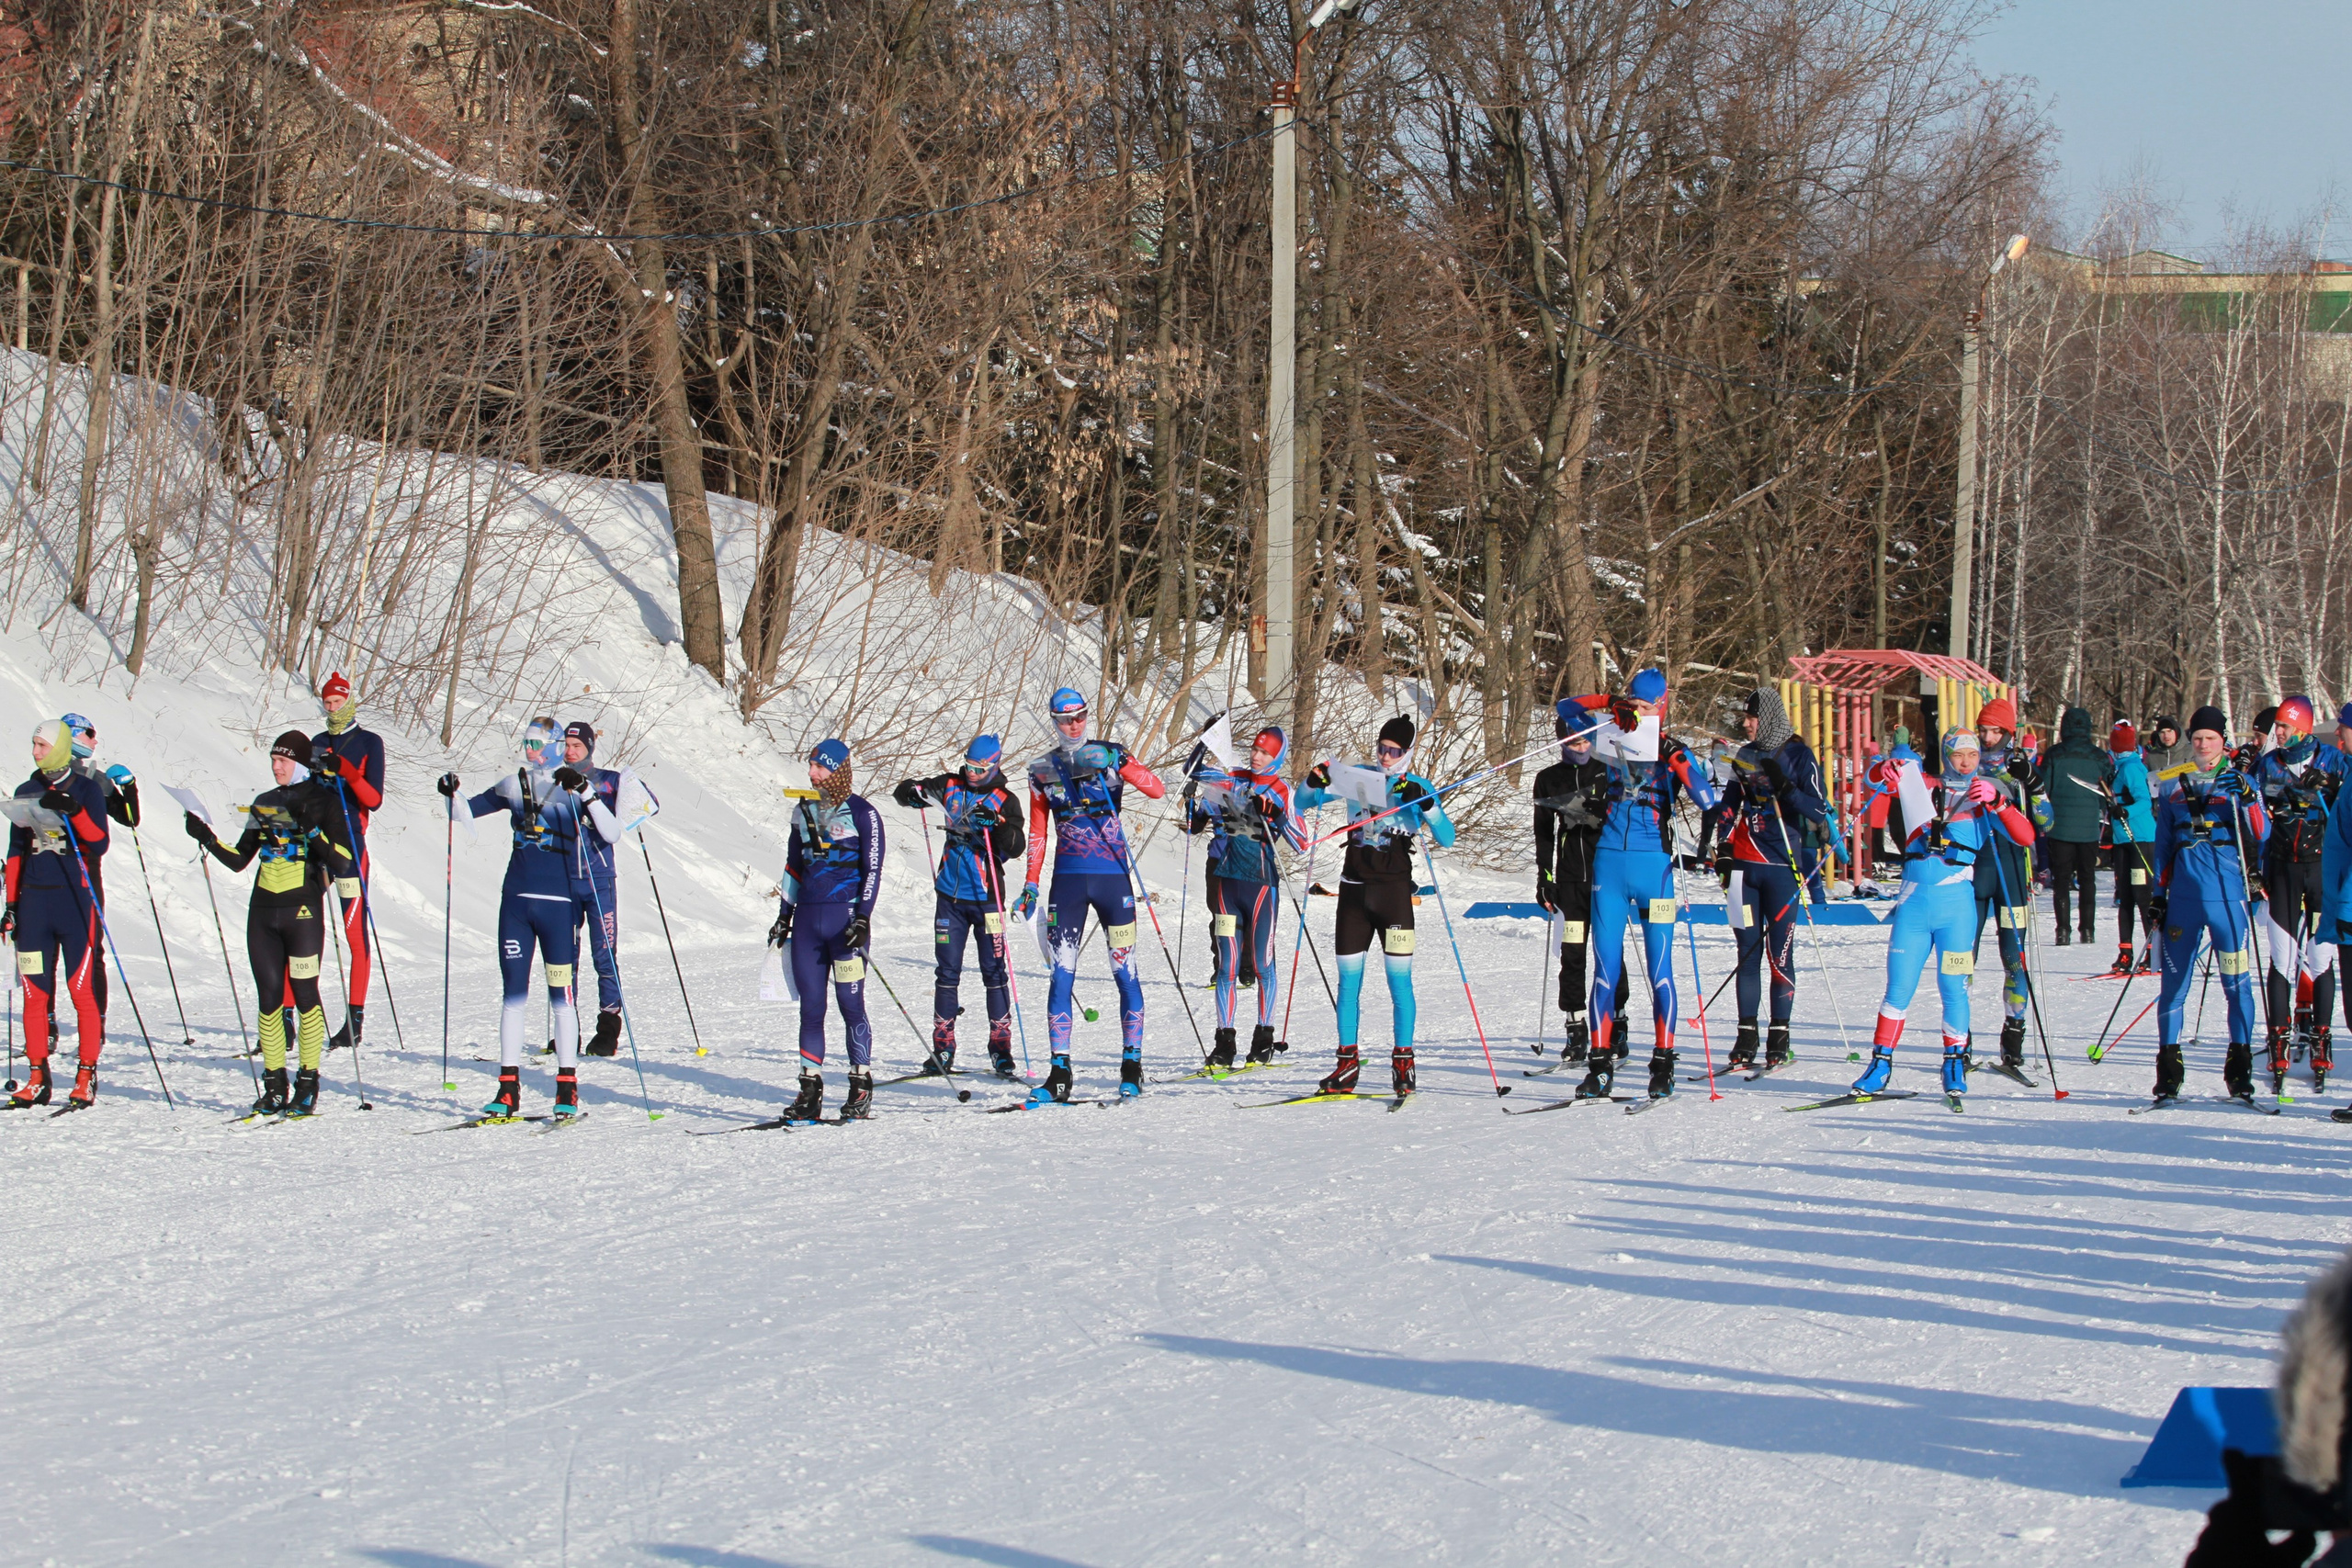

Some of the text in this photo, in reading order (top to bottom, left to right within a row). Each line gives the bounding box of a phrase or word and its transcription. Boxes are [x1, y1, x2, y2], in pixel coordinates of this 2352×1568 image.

[604, 911, 615, 949] RUSSIA
[1114, 930, 1129, 938] 105
[19, 956, 32, 964] 109
[485, 1116, 525, 1125] FISCHER
